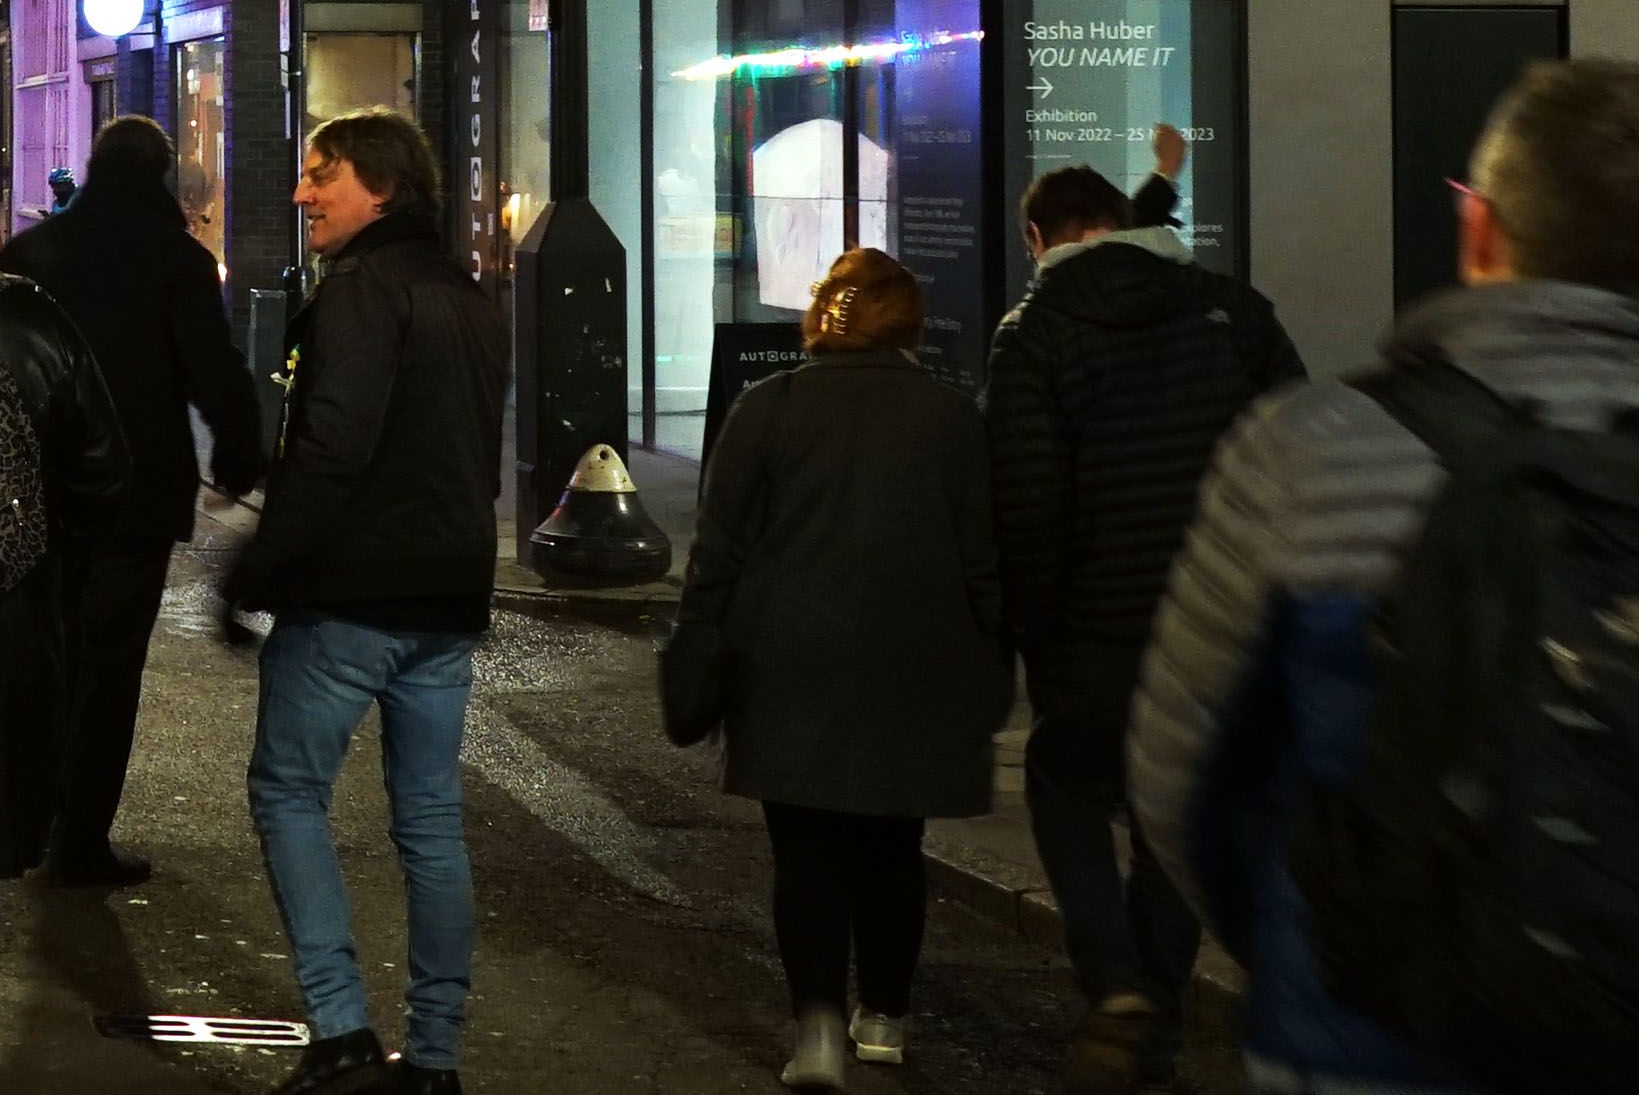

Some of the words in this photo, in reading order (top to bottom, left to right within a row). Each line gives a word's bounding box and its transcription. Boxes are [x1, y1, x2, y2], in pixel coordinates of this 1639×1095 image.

[1024, 20, 1084, 40] Sasha
[1090, 20, 1155, 40] Huber
[1027, 47, 1075, 67] YOU
[1079, 47, 1149, 67] NAME
[1153, 47, 1176, 67] IT
[1025, 109, 1098, 123] Exhibition
[1026, 129, 1041, 142] 11
[1045, 129, 1074, 142] Nov
[1078, 128, 1112, 142] 2022
[1127, 128, 1145, 142] 25
[739, 350, 810, 362] AUTOGRA
